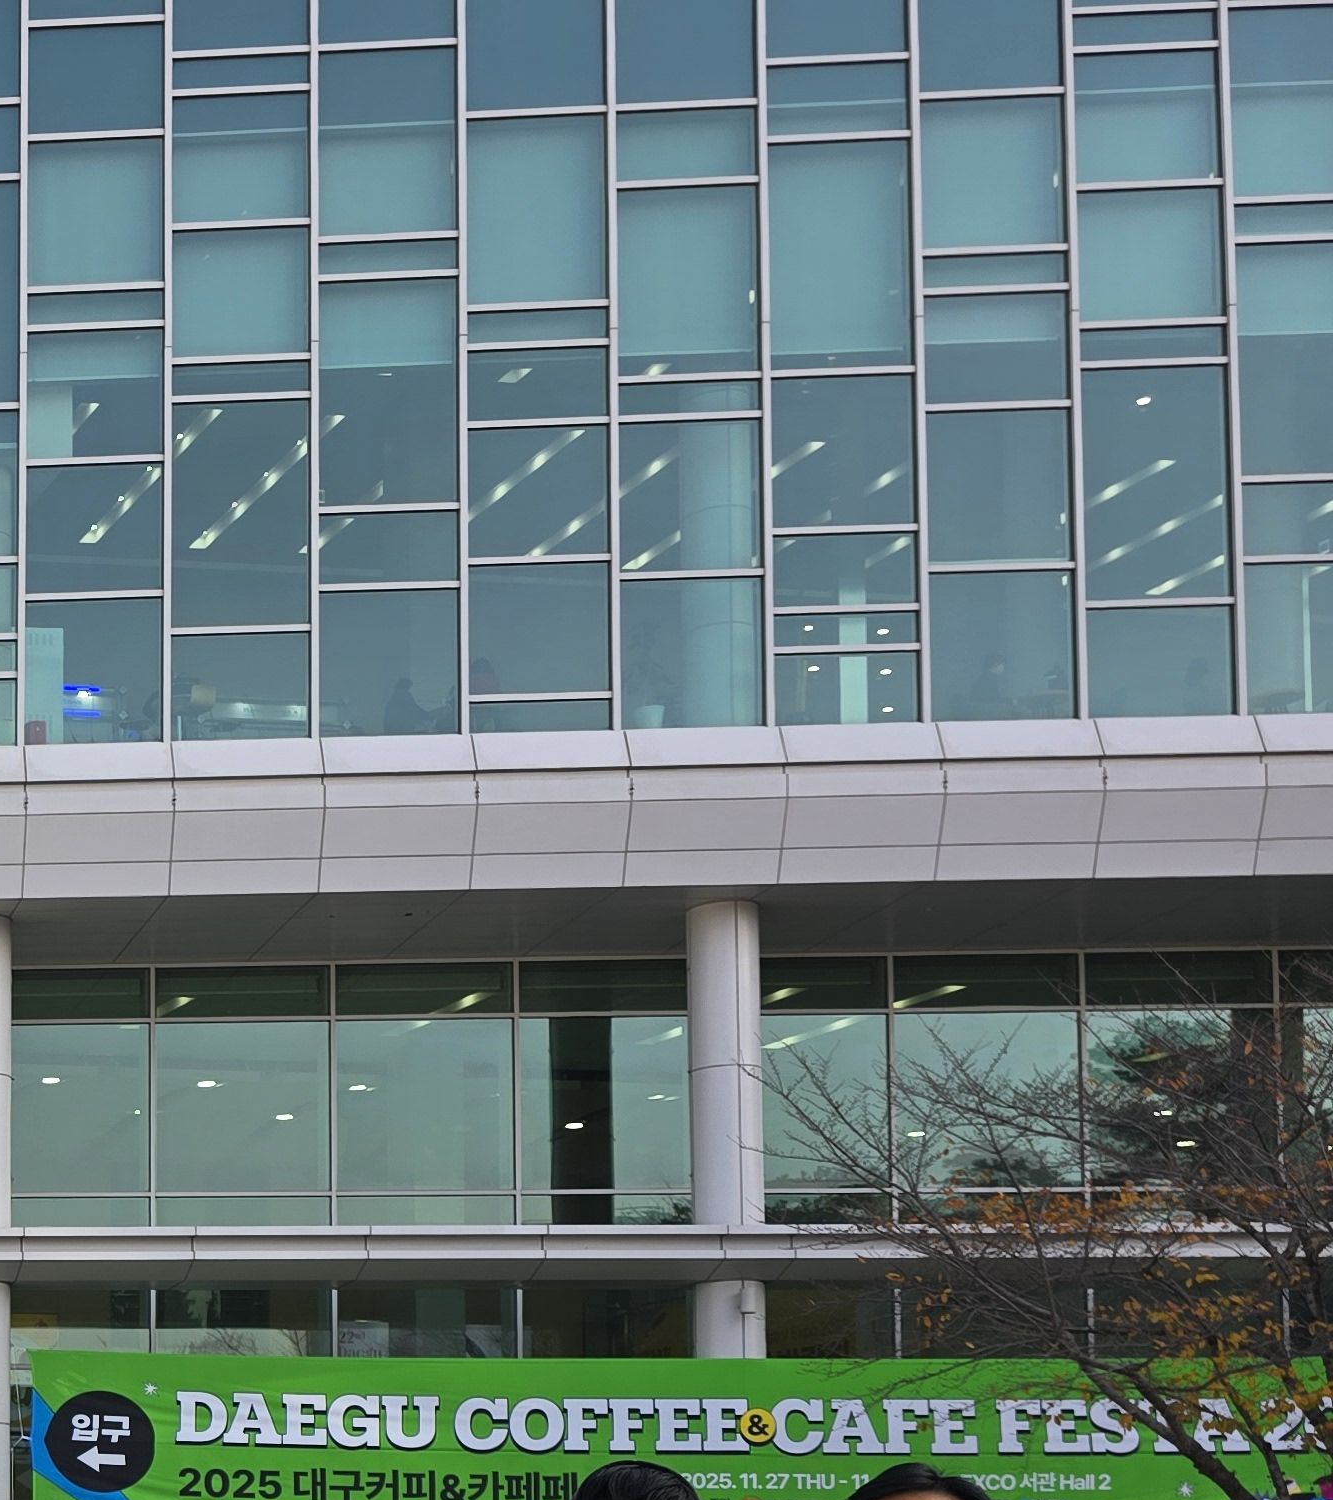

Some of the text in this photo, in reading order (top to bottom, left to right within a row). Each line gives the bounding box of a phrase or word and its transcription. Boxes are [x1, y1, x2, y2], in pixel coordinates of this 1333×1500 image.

[71, 1414, 131, 1443] 입구
[175, 1391, 439, 1450] DAEGU
[179, 1467, 282, 1499] 2025
[793, 1473, 836, 1490] THU
[1020, 1472, 1056, 1492] 서관
[1060, 1473, 1095, 1490] Hall
[1098, 1473, 1112, 1490] 2
